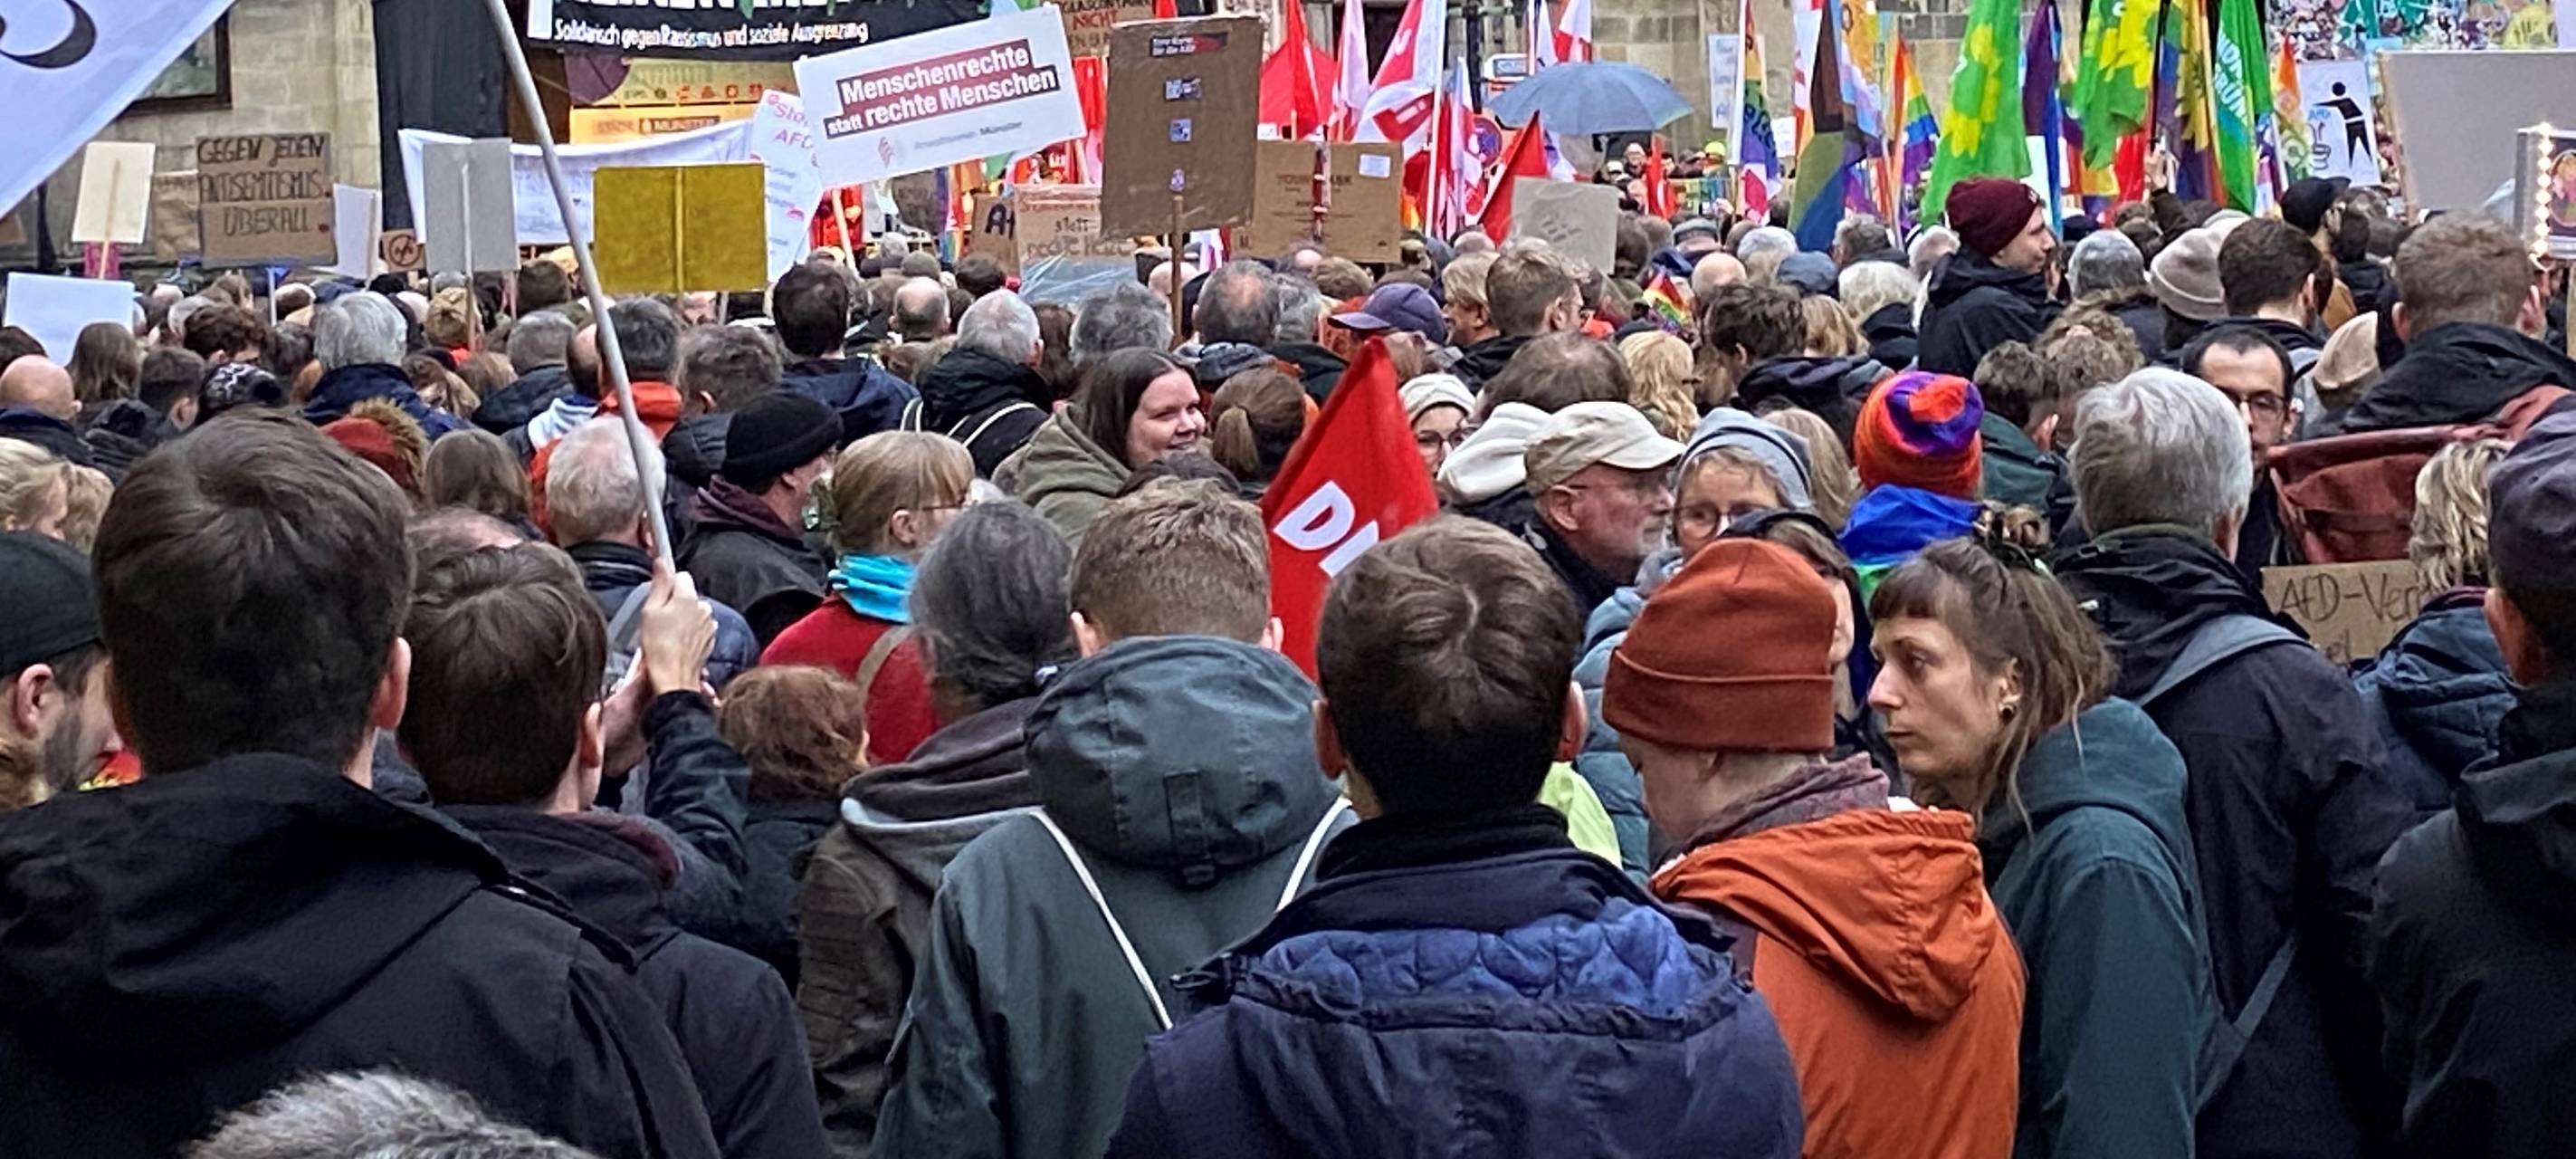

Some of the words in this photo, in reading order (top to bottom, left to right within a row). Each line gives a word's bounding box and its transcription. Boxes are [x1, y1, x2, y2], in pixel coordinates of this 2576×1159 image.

[554, 18, 621, 45] Solidarisch
[621, 28, 661, 49] gegen
[660, 24, 722, 48] Rassismus
[723, 24, 748, 46] und
[749, 22, 790, 44] soziale
[791, 22, 869, 43] Ausgrenzung
[1072, 7, 1118, 31] NICHT
[841, 46, 1029, 105] Menschenrechte
[774, 103, 811, 128] Sto
[826, 115, 865, 136] statt
[865, 96, 939, 128] rechte
[940, 69, 1057, 111] Menschen
[196, 138, 263, 165] GEGEN
[268, 135, 325, 168] JEDEN
[2280, 571, 2420, 623] AfD-Ver
